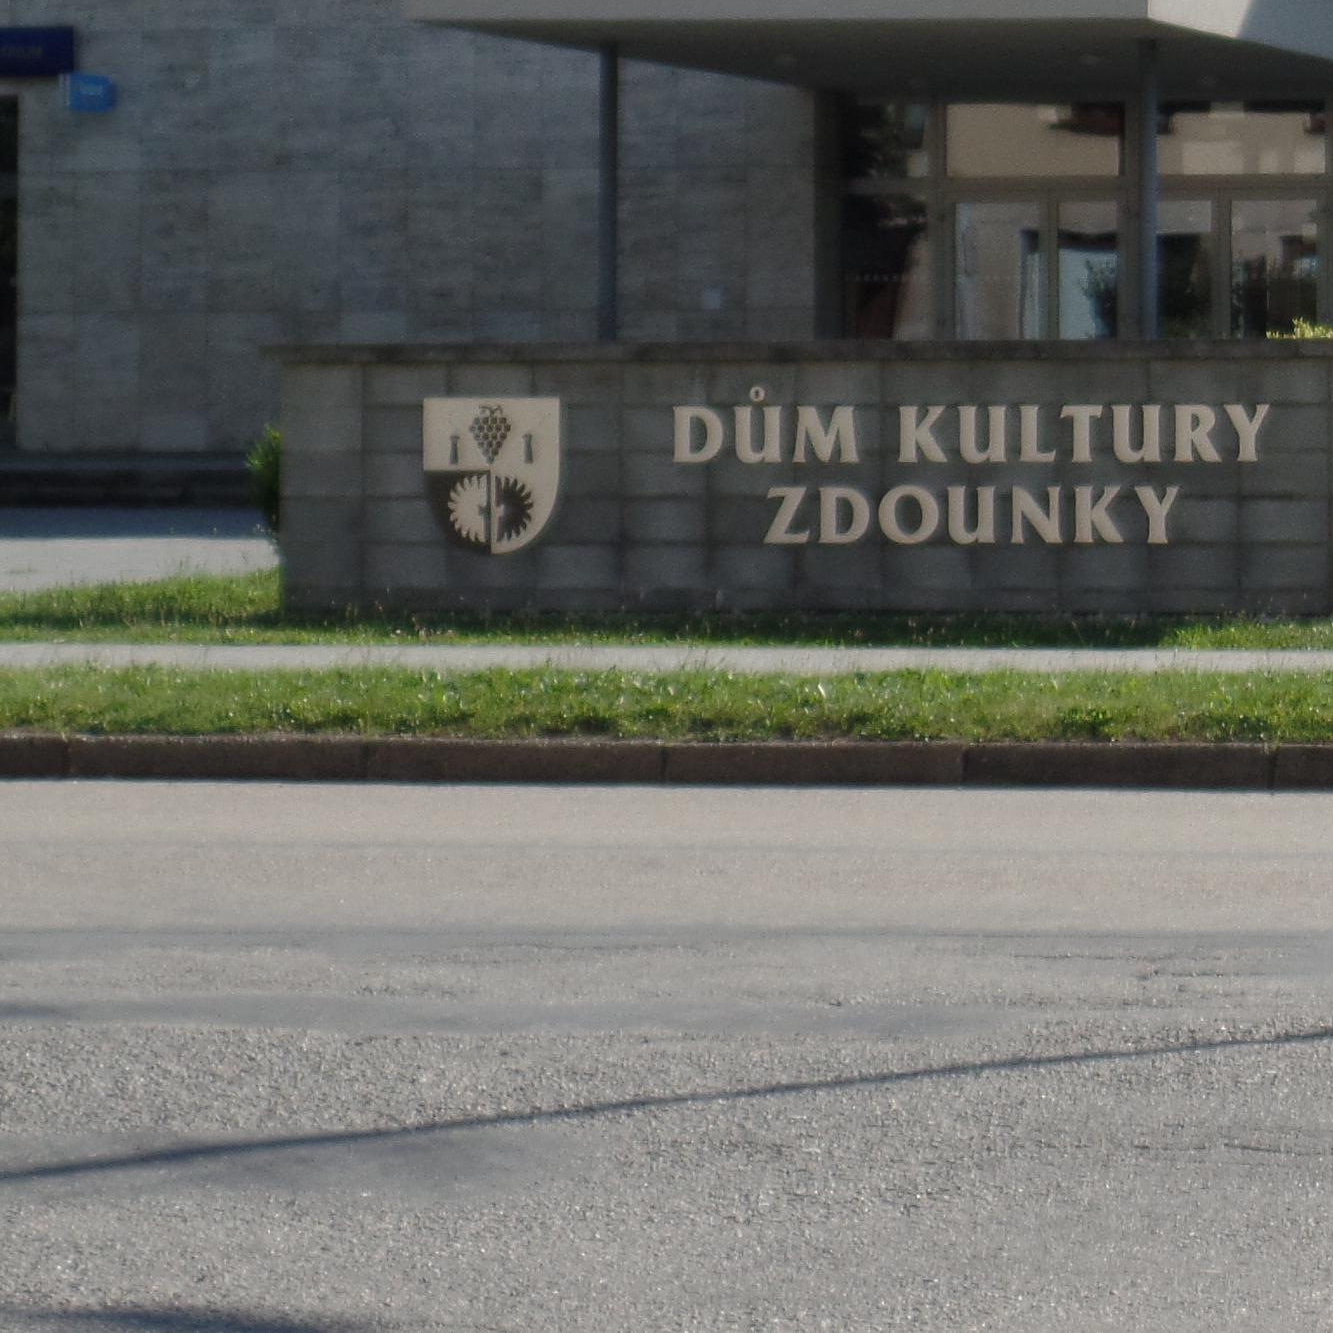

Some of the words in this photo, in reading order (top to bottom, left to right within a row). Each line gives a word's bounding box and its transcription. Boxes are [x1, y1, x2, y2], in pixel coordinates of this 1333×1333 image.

[673, 386, 860, 464] DŮM
[897, 404, 1270, 464] KULTURY
[763, 485, 1179, 545] ZDOUNKY
